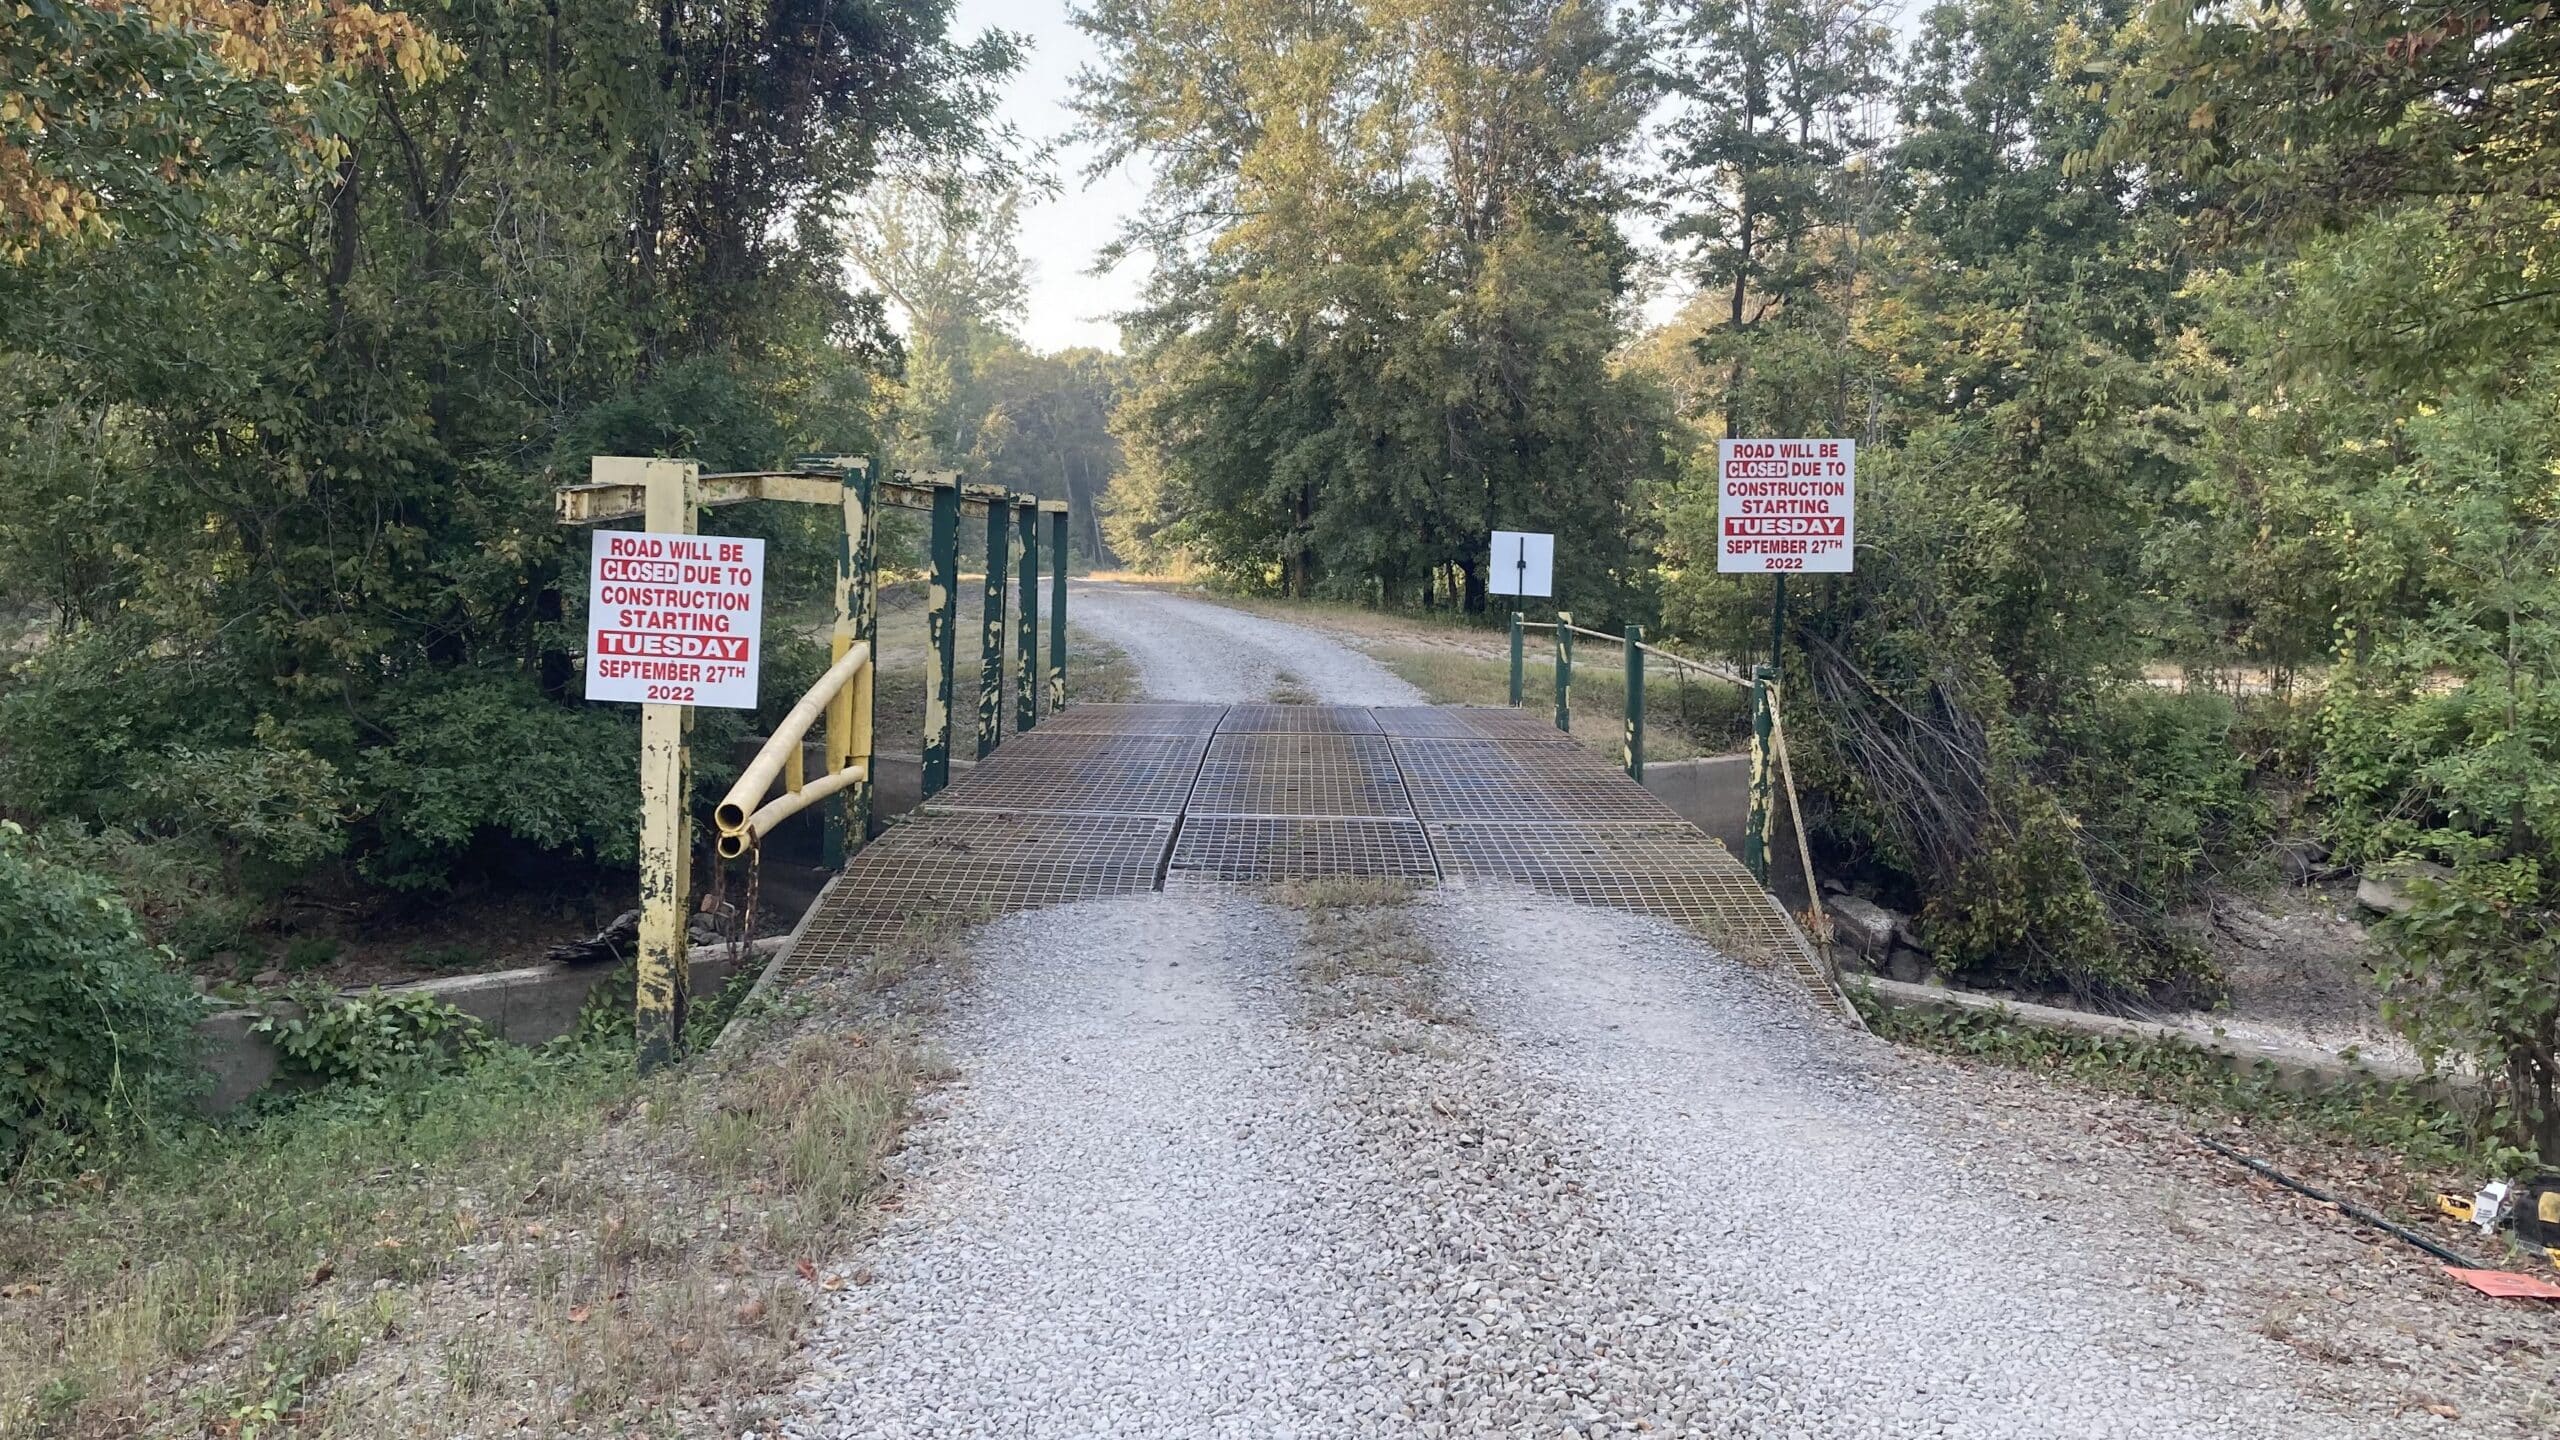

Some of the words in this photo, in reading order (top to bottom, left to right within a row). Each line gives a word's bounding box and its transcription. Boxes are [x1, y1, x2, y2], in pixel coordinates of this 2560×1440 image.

[1734, 444, 1774, 458] ROAD
[1780, 444, 1814, 458] WILL
[1819, 444, 1838, 457] BE
[1728, 462, 1787, 477] CLOSED
[1792, 462, 1821, 476] DUE
[1826, 462, 1845, 475] TO
[1727, 482, 1844, 496] CONSTRUCTION
[1742, 500, 1829, 513] STARTING
[1729, 519, 1840, 534] TUESDAY
[611, 538, 662, 558] ROAD
[670, 541, 712, 560] WILL
[719, 544, 743, 562] BE
[1727, 540, 1807, 554] SEPTEMBER
[1811, 540, 1842, 554] 27TH
[1766, 558, 1803, 569] 2022
[603, 560, 678, 583] CLOSED
[684, 565, 721, 584] DUE
[728, 568, 752, 586] TO
[601, 586, 749, 611] CONSTRUCTION
[619, 610, 729, 632] STARTING
[603, 633, 743, 658] TUESDAY
[599, 660, 700, 682] SEPTEMBER
[706, 666, 745, 683] 27TH
[648, 685, 694, 701] 2022
